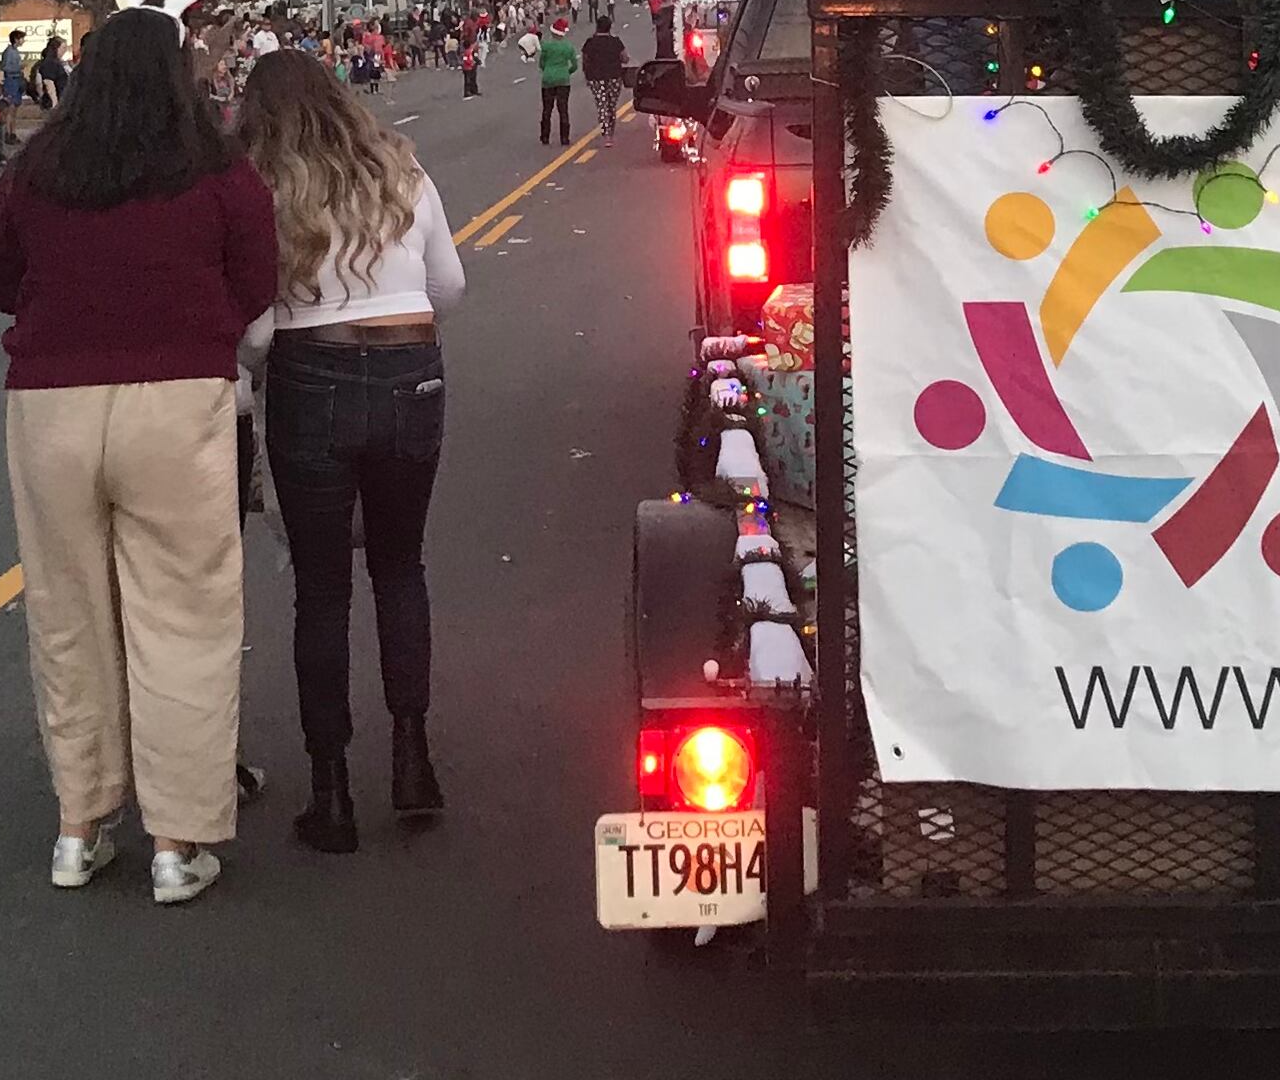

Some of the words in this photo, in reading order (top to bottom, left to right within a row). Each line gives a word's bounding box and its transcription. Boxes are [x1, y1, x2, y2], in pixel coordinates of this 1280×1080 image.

[646, 818, 766, 840] GEORGIA
[618, 840, 766, 898] TT98H4
[699, 903, 719, 916] TIFT
